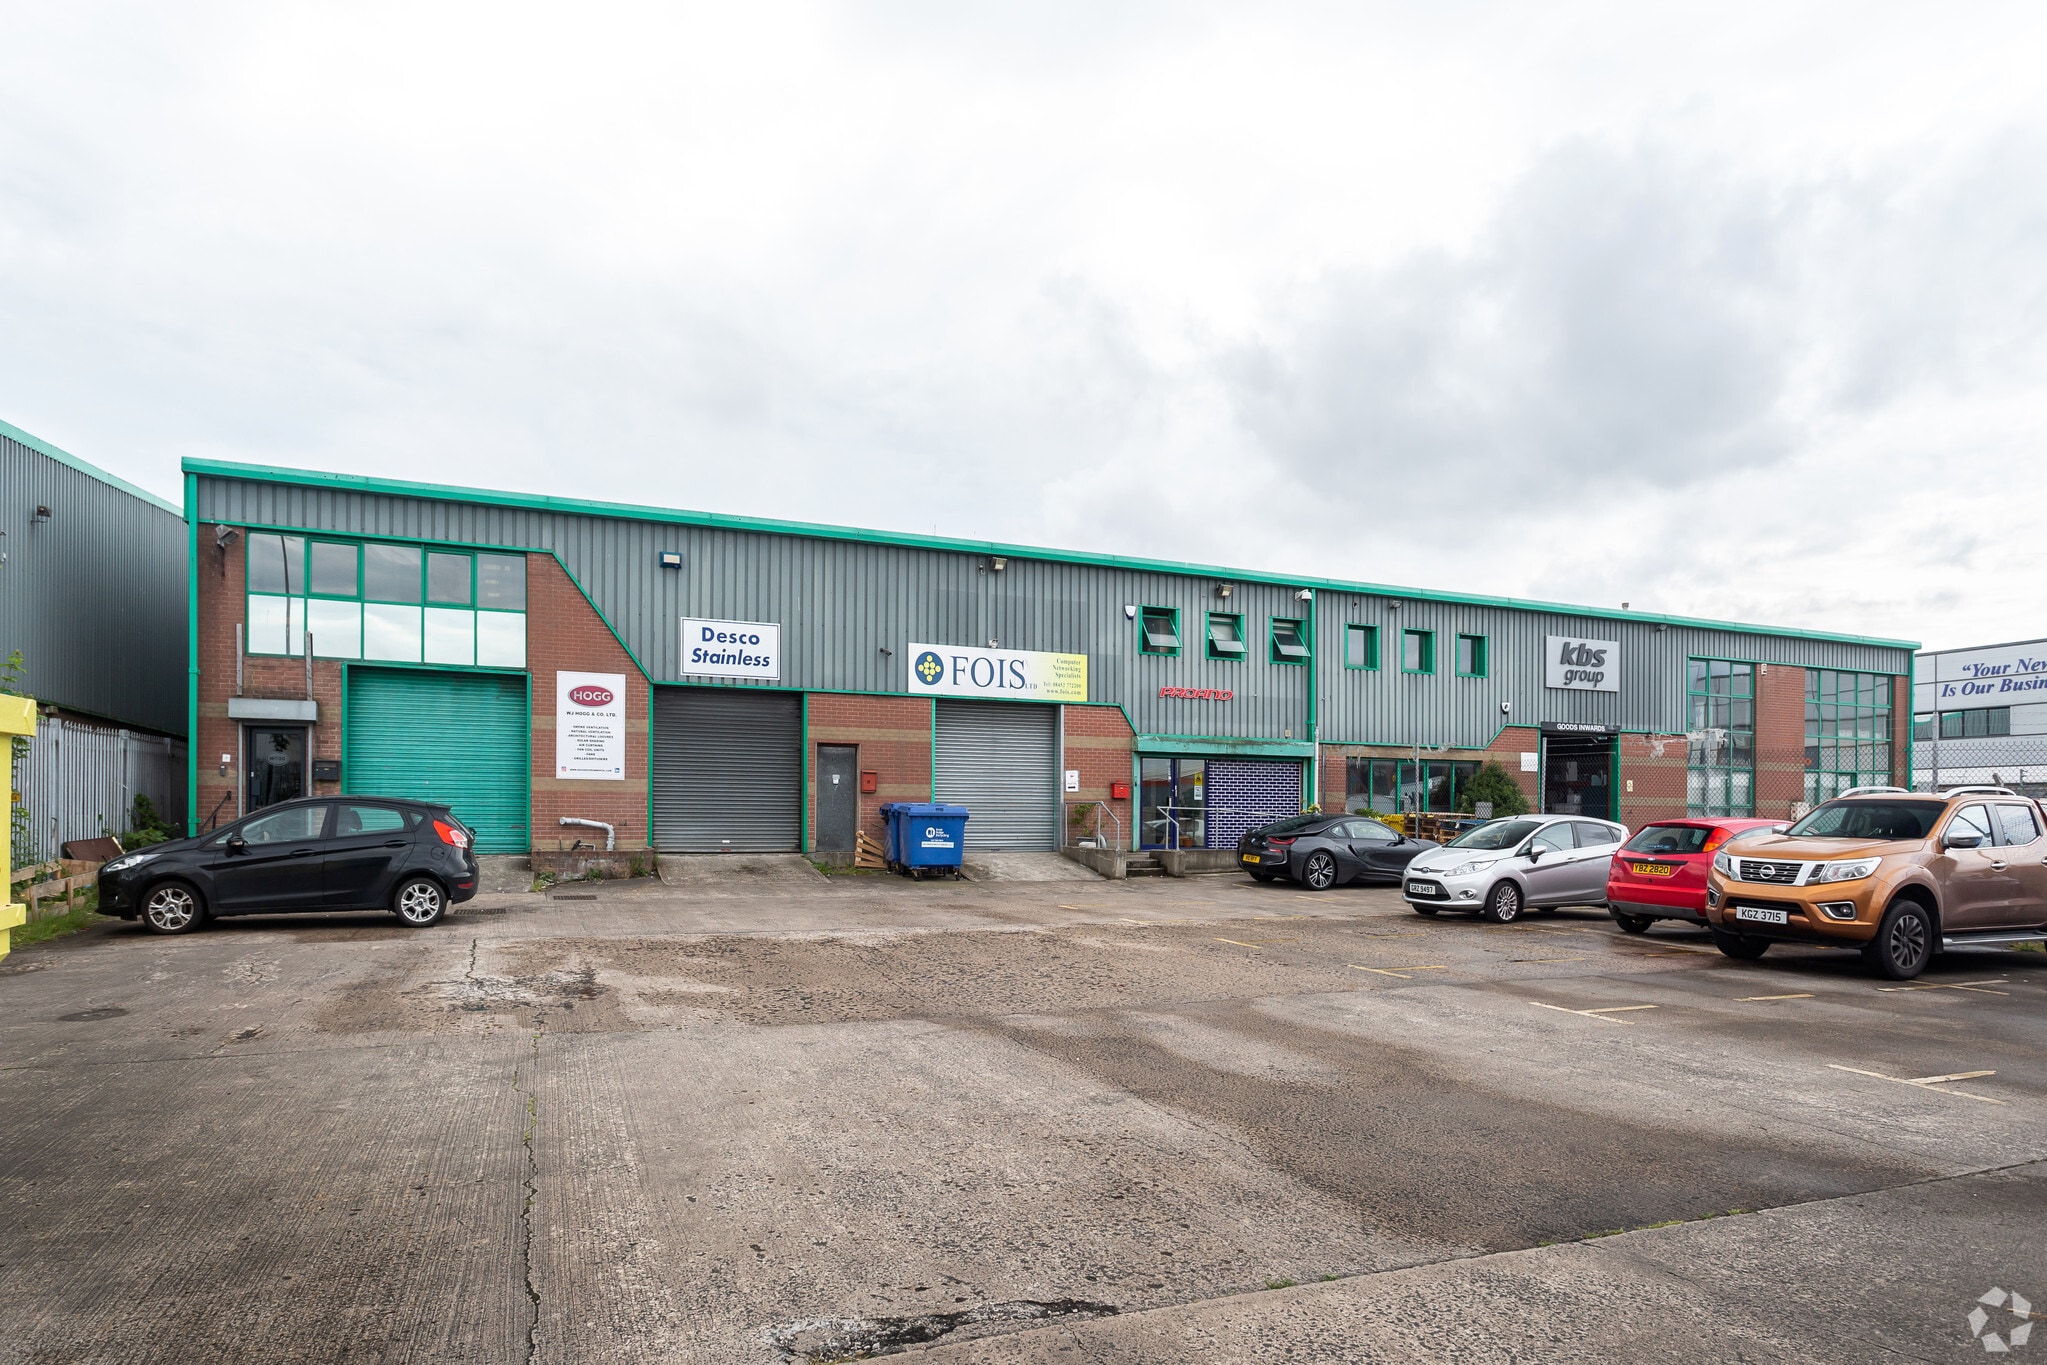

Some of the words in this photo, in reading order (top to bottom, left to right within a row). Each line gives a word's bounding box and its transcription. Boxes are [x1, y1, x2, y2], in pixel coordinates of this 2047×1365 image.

[702, 626, 760, 645] Desco
[691, 647, 770, 667] Stainless
[1560, 641, 1607, 668] kbs
[950, 656, 1026, 690] FOIS
[1052, 664, 1081, 673] Networking
[1563, 669, 1604, 688] group
[573, 690, 611, 701] HOGG
[1940, 683, 1956, 697] Is
[1961, 681, 1995, 696] Our
[1634, 864, 1649, 873] YBZ
[1649, 865, 1669, 874] 2820
[1741, 909, 1758, 919] KGZ
[1760, 911, 1781, 922] 3715
